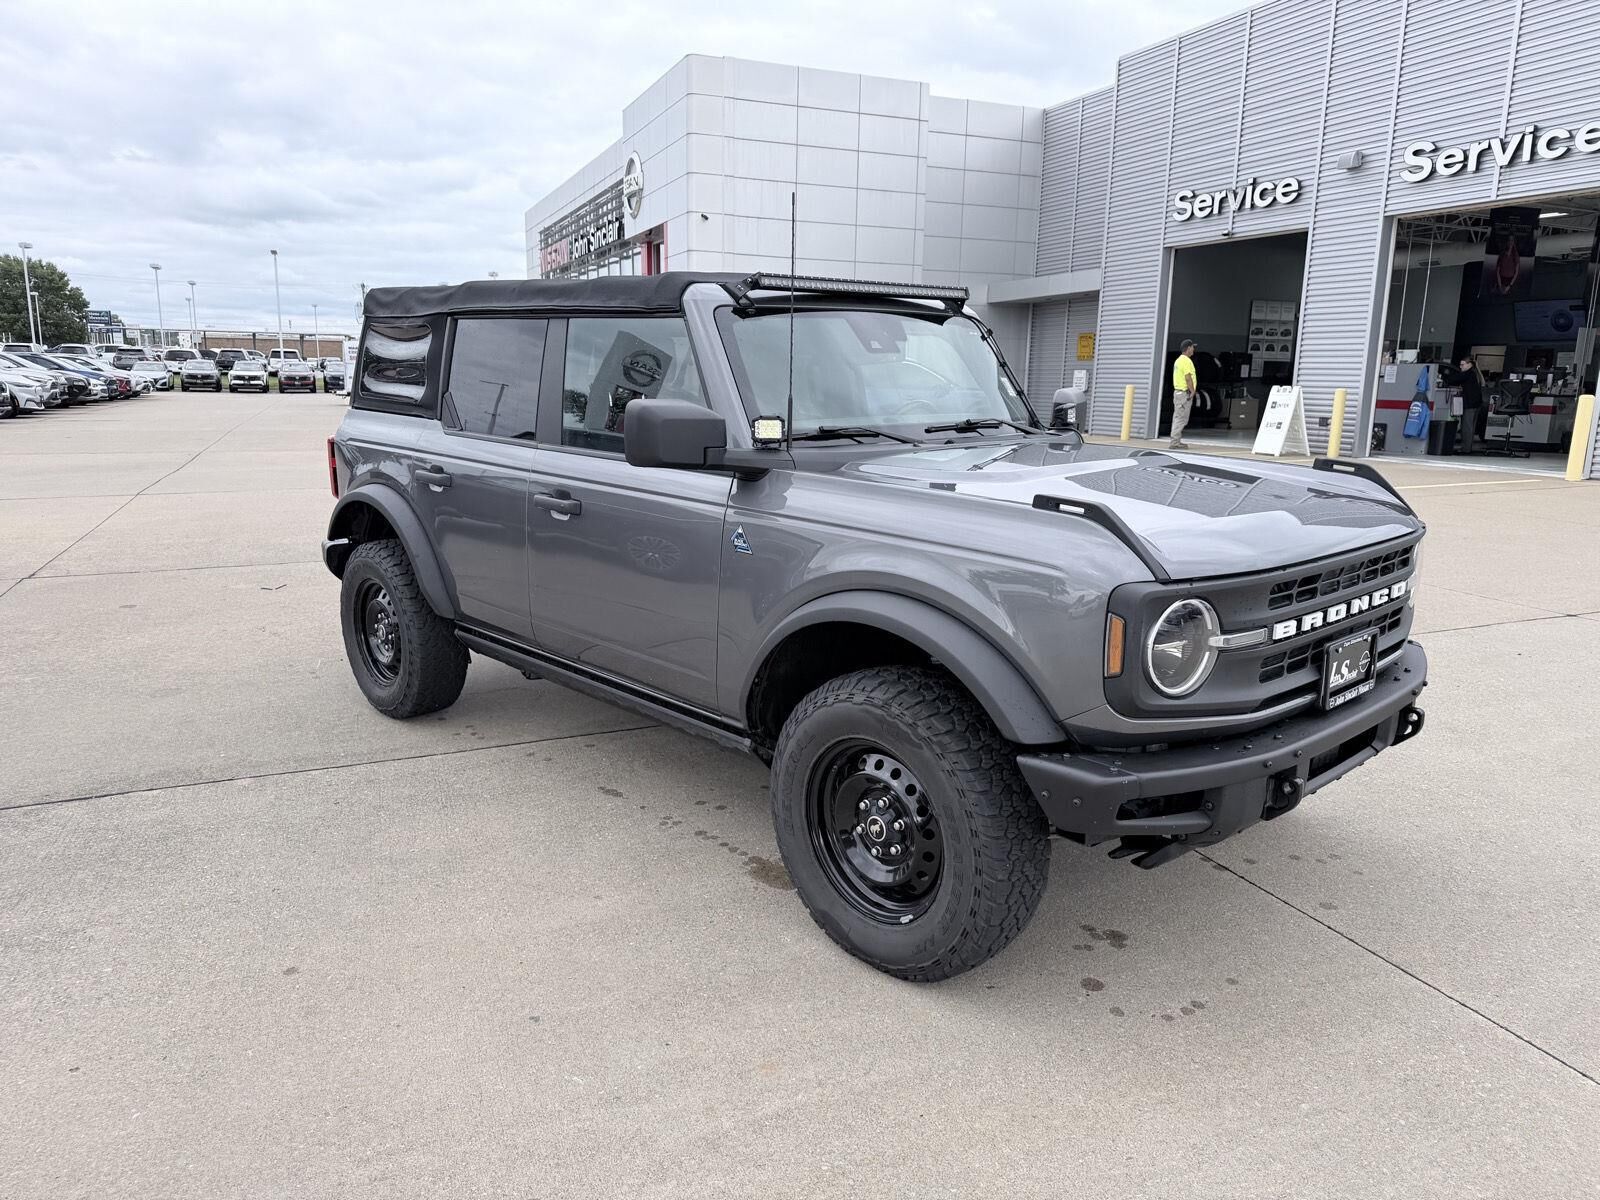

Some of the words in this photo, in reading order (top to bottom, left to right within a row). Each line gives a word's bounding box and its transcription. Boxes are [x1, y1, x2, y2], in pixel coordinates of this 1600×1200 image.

[1400, 119, 1600, 182] Service
[1173, 177, 1300, 222] Service
[572, 233, 589, 260] John
[589, 219, 620, 251] Sinclair
[1273, 581, 1407, 640] BRONCO
